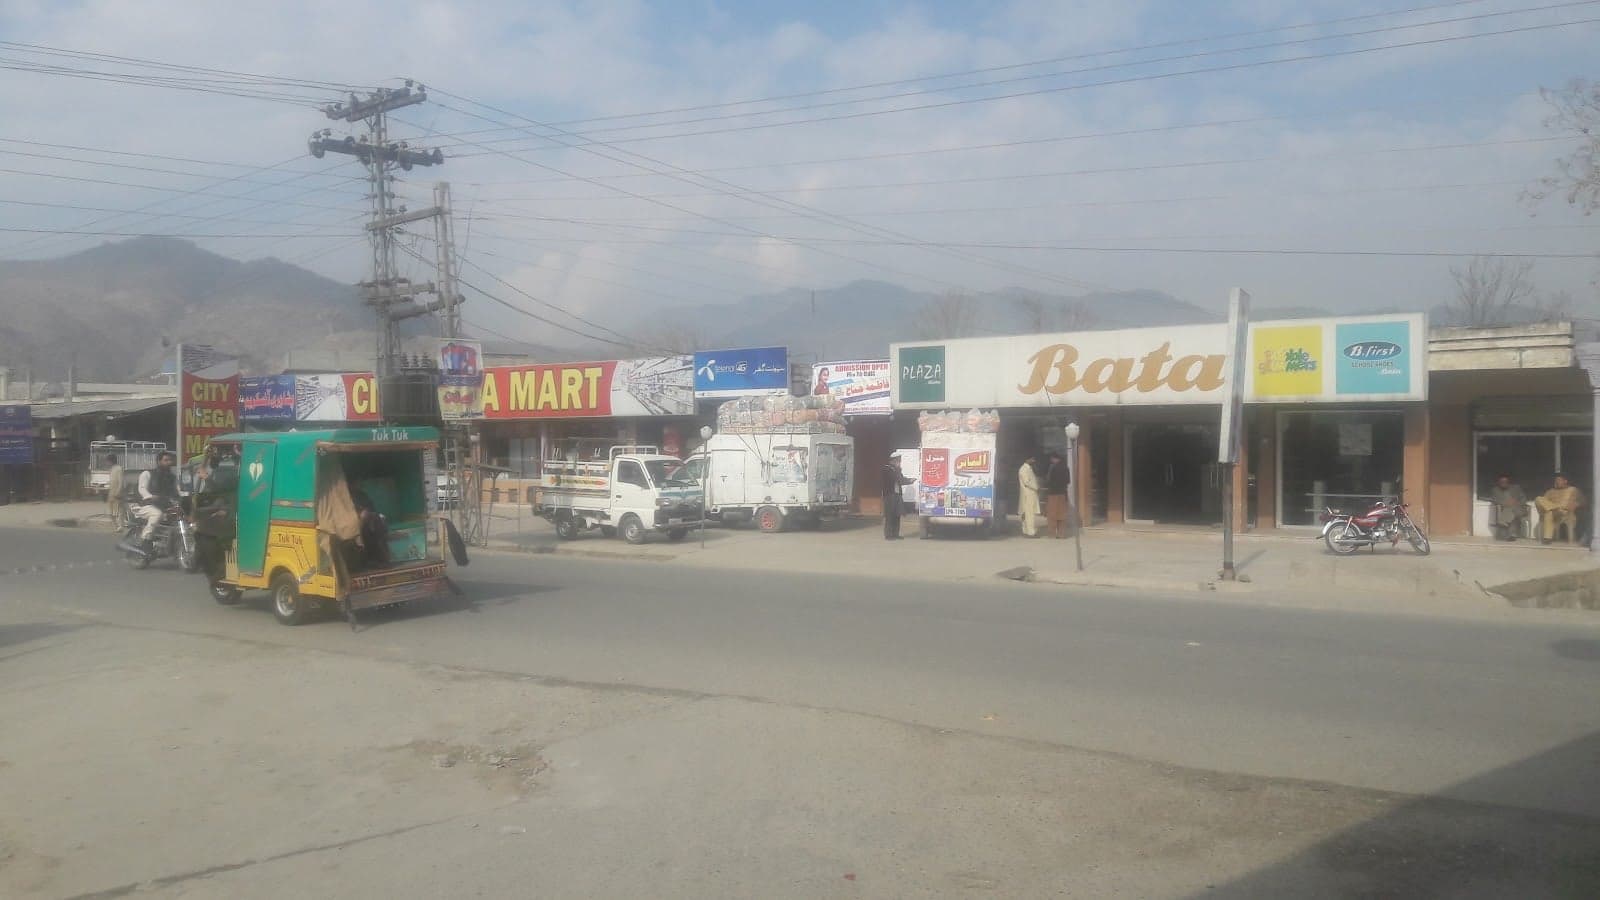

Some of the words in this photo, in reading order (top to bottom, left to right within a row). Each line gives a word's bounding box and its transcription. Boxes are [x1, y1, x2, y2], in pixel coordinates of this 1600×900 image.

[835, 364, 871, 372] ADMISSION
[902, 364, 941, 380] PLAZA
[1017, 341, 1226, 395] Bata
[191, 382, 230, 402] CITY
[510, 368, 602, 411] MART
[184, 408, 236, 429] MEGA
[372, 429, 389, 440] Tuk
[392, 429, 409, 440] Tuk
[278, 532, 290, 543] Tuk
